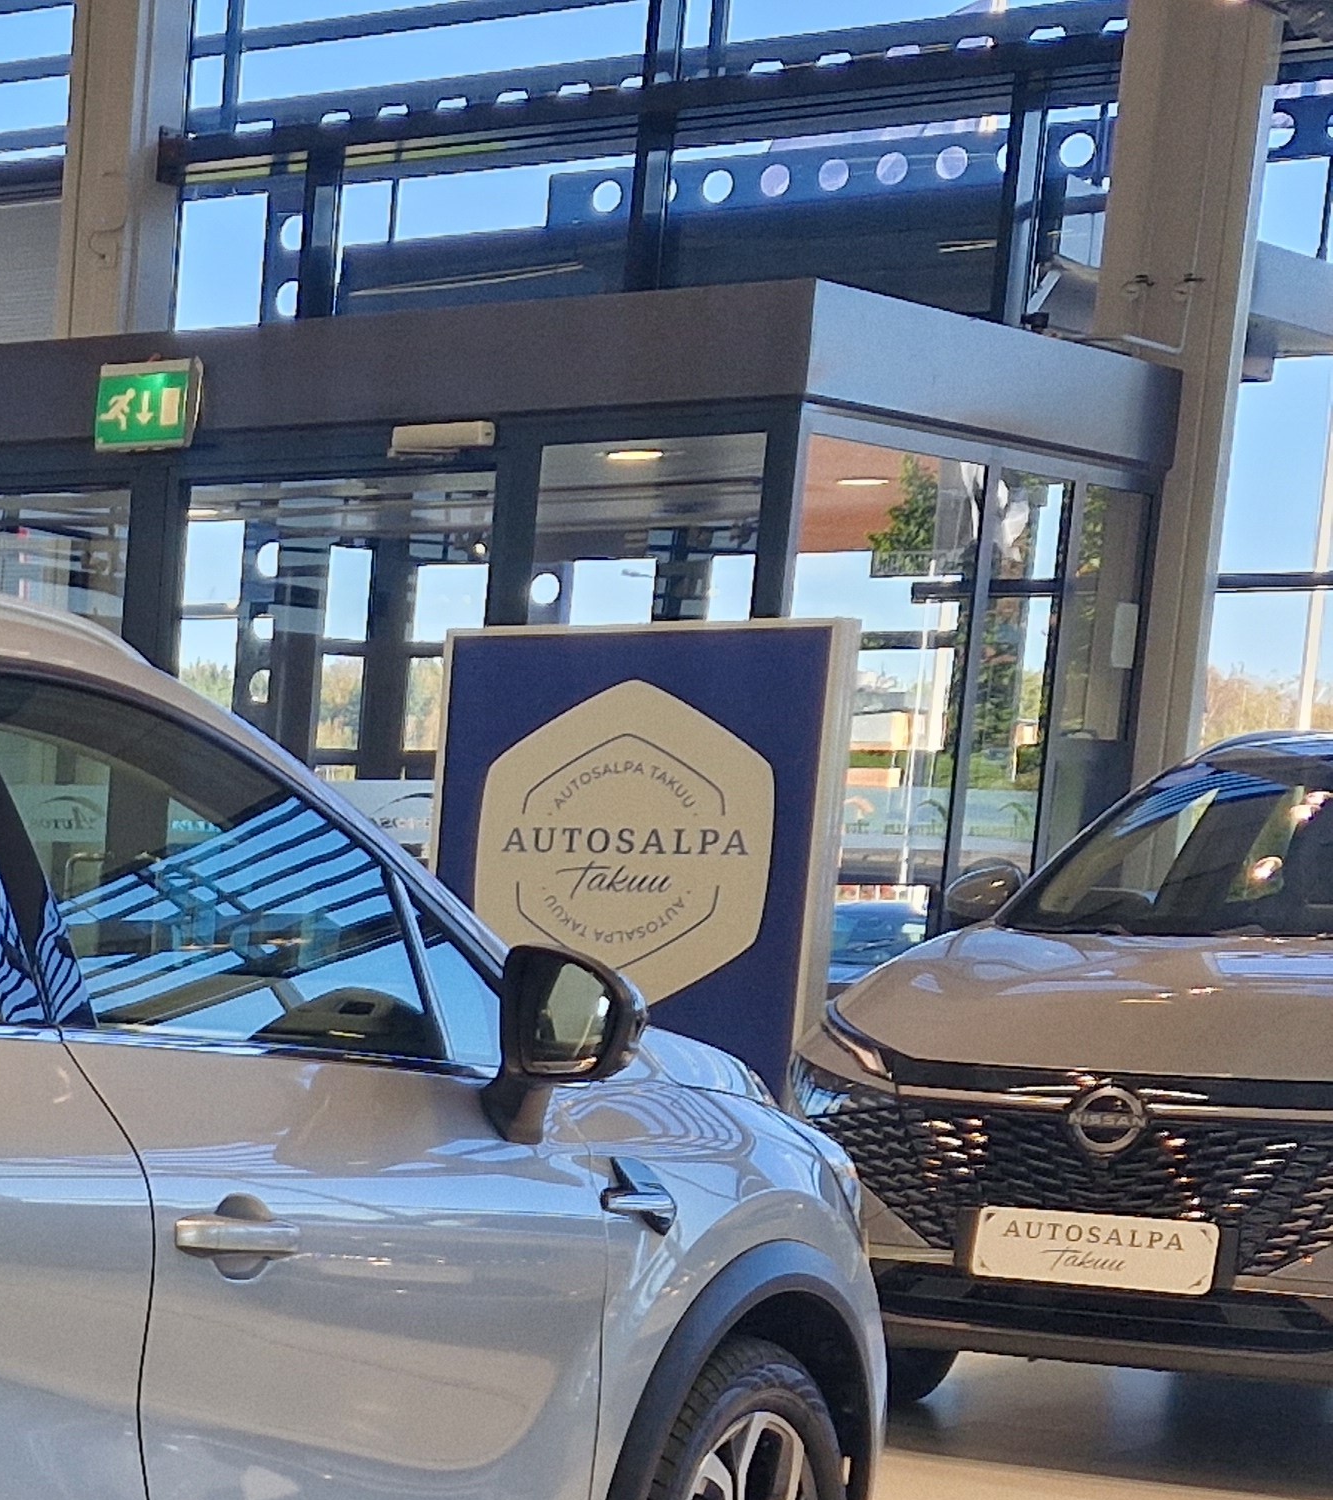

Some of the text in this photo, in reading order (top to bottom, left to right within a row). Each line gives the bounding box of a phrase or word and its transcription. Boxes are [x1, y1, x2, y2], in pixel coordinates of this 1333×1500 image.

[554, 760, 696, 810] AUTOSALPA TAKUU
[501, 827, 749, 855] AUTOSALPA
[556, 860, 672, 900] Takuu
[544, 894, 685, 944] AUTOSALPA TAKUU
[1067, 1111, 1147, 1128] NISSAN
[1003, 1220, 1185, 1251] AUTOSALPA
[1040, 1246, 1127, 1272] Takuu
